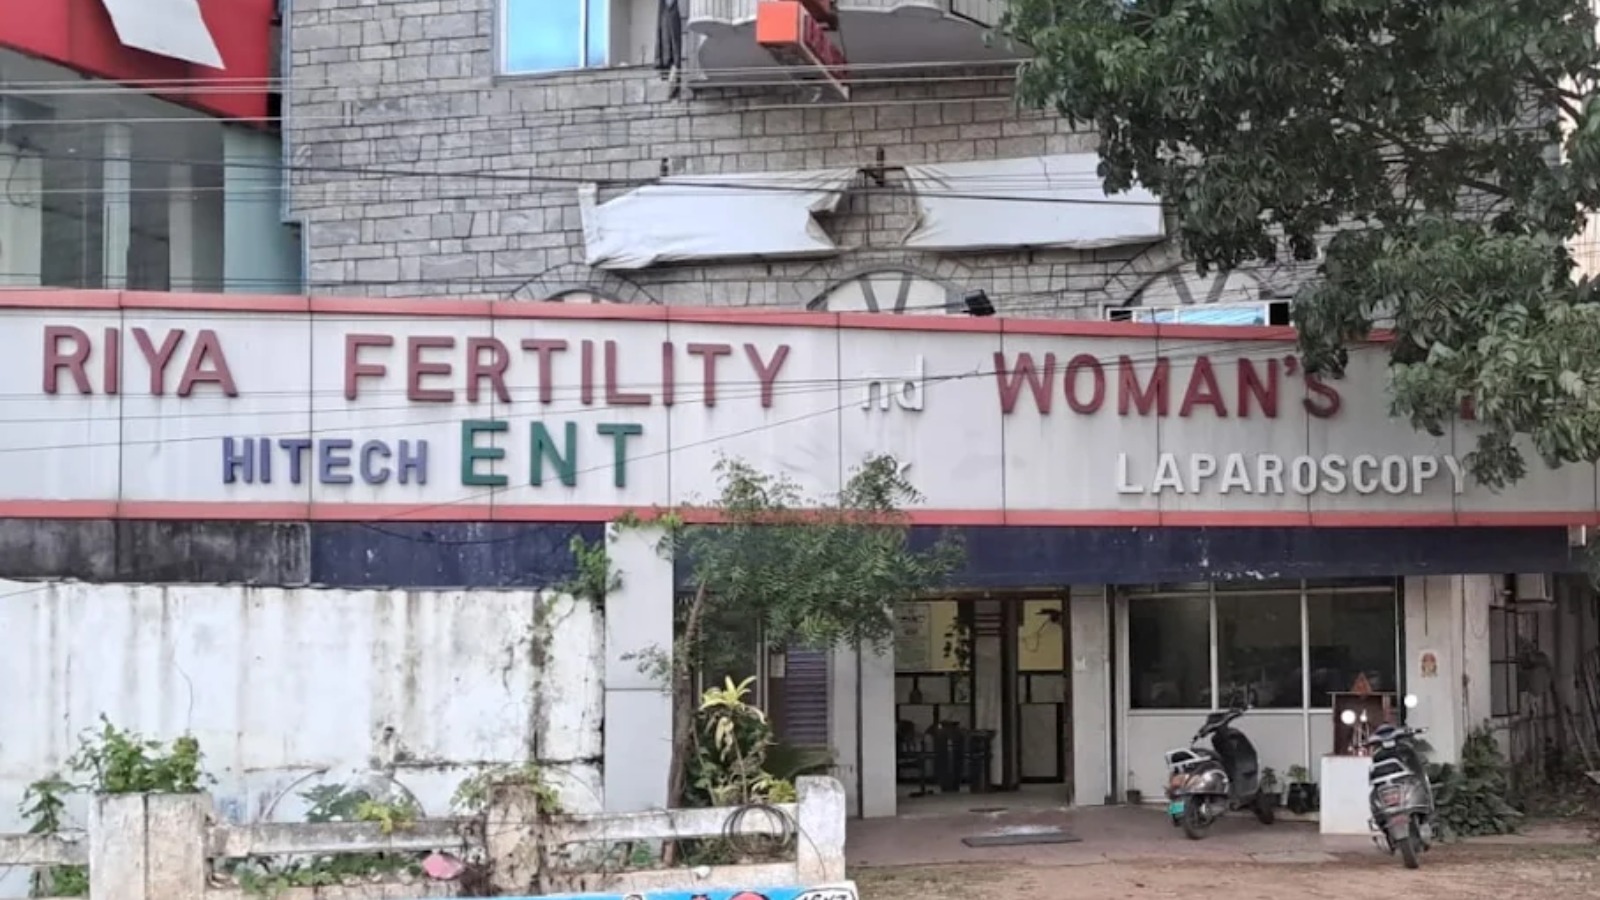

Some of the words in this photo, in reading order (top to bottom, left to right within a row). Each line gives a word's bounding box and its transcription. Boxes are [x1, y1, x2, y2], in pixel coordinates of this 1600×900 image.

[42, 325, 238, 398] RIYA
[344, 334, 791, 409] FERTILITY
[993, 351, 1342, 419] WOMAN'S
[222, 435, 428, 486] HITECH
[460, 419, 643, 489] ENT
[1116, 452, 1467, 495] LAPAROSCOPY
